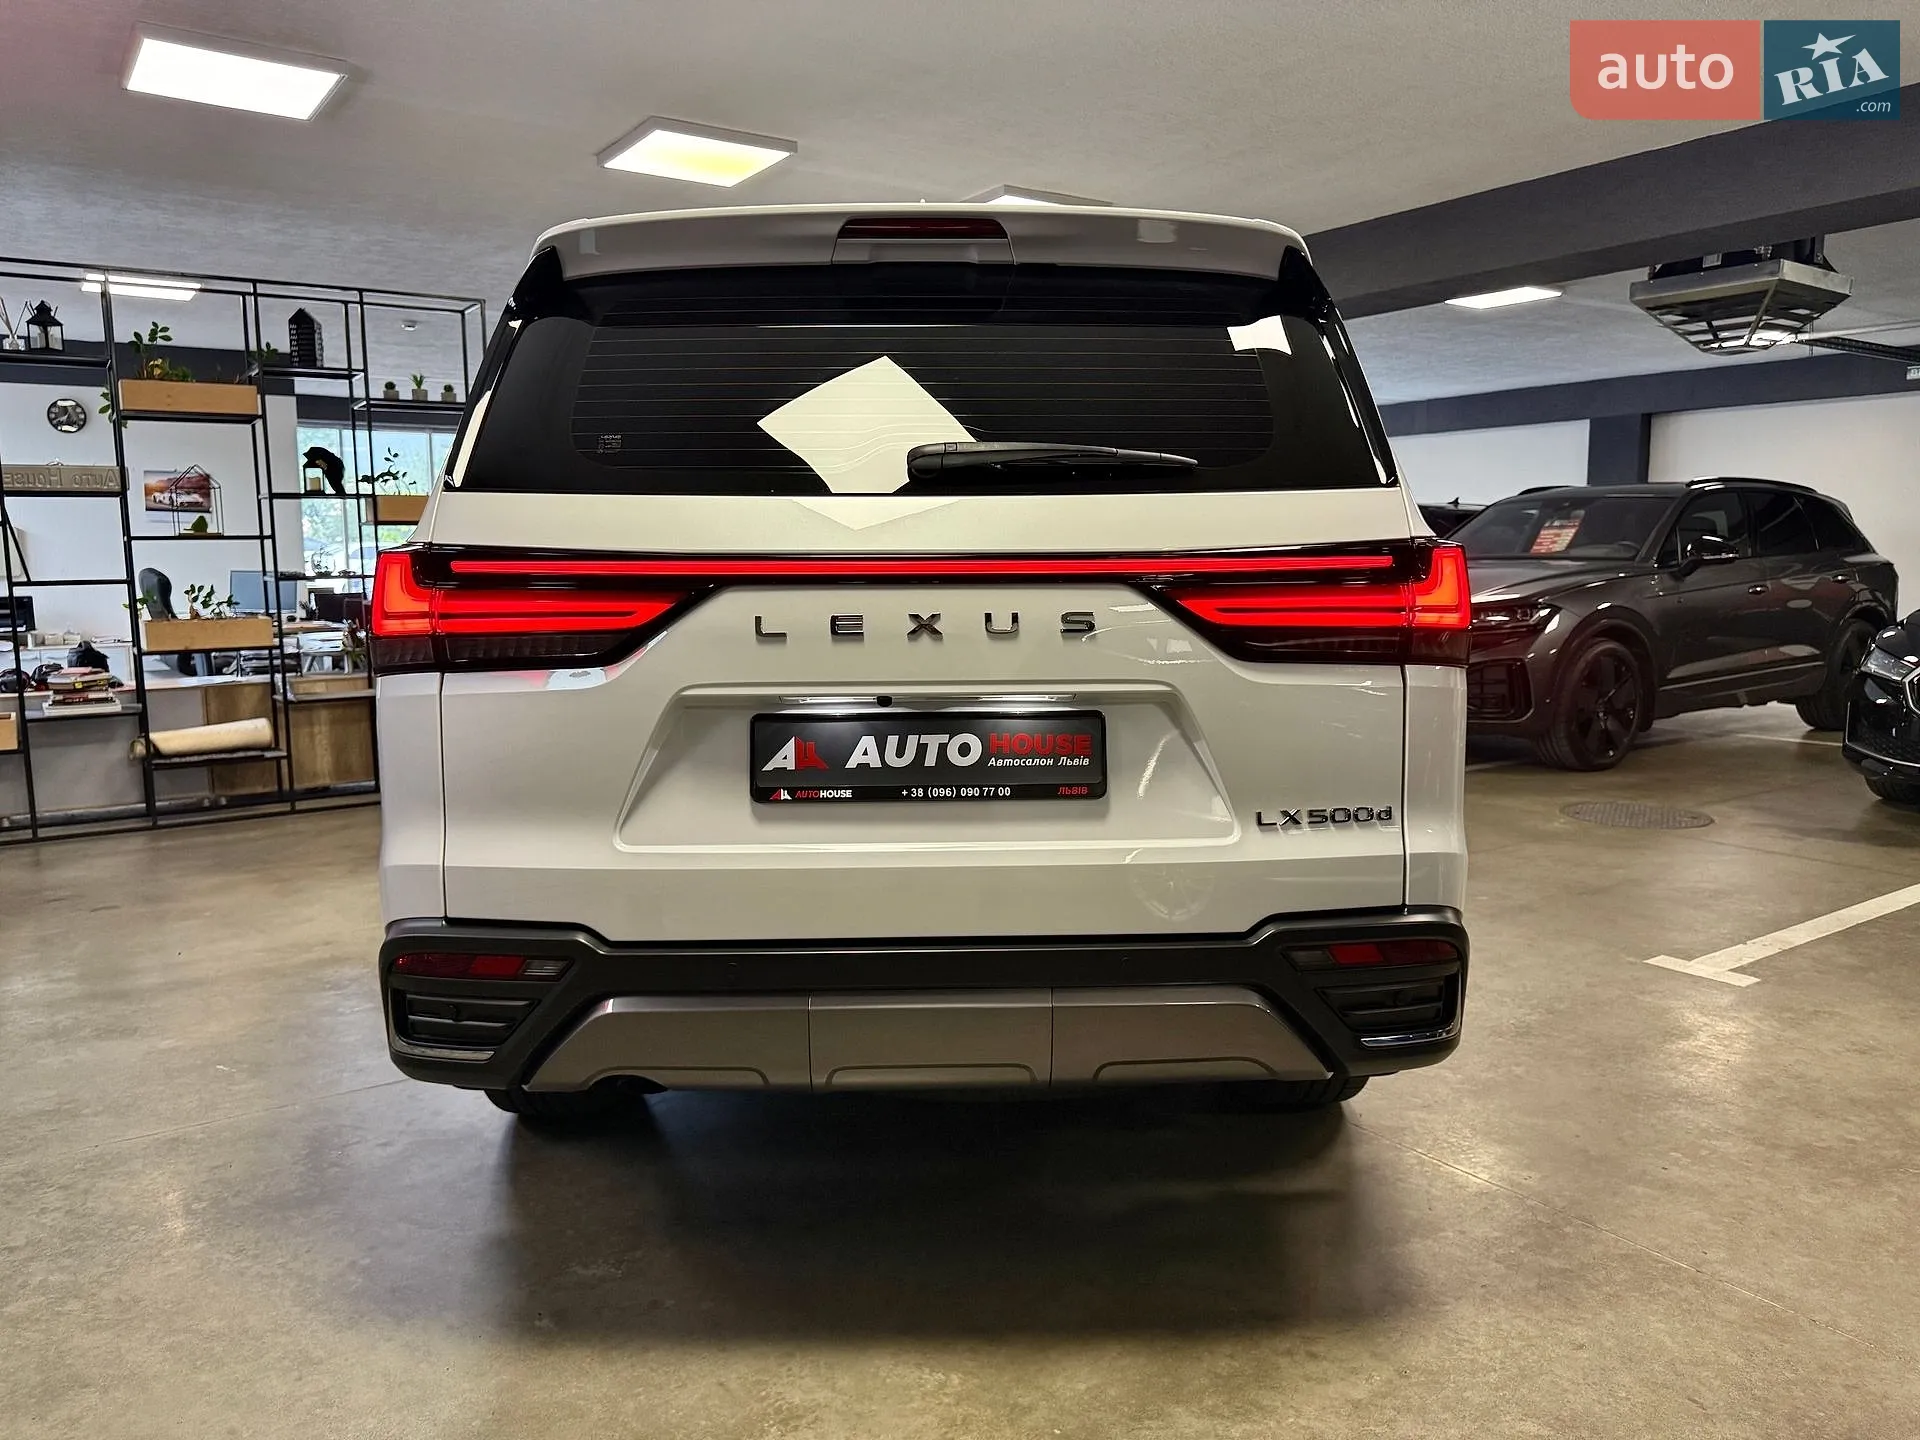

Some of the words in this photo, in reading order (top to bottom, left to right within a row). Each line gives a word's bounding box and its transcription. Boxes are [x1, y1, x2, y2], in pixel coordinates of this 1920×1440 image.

[754, 611, 1096, 639] LEXUS
[844, 733, 983, 769] AUTO
[988, 732, 1093, 755] HOUSE
[987, 757, 1054, 767] Автосалон
[1057, 755, 1090, 767] Львів
[910, 788, 924, 797] 38
[927, 786, 957, 798] (096)
[960, 787, 980, 797] 090
[982, 787, 996, 797] 77
[997, 786, 1011, 797] 00
